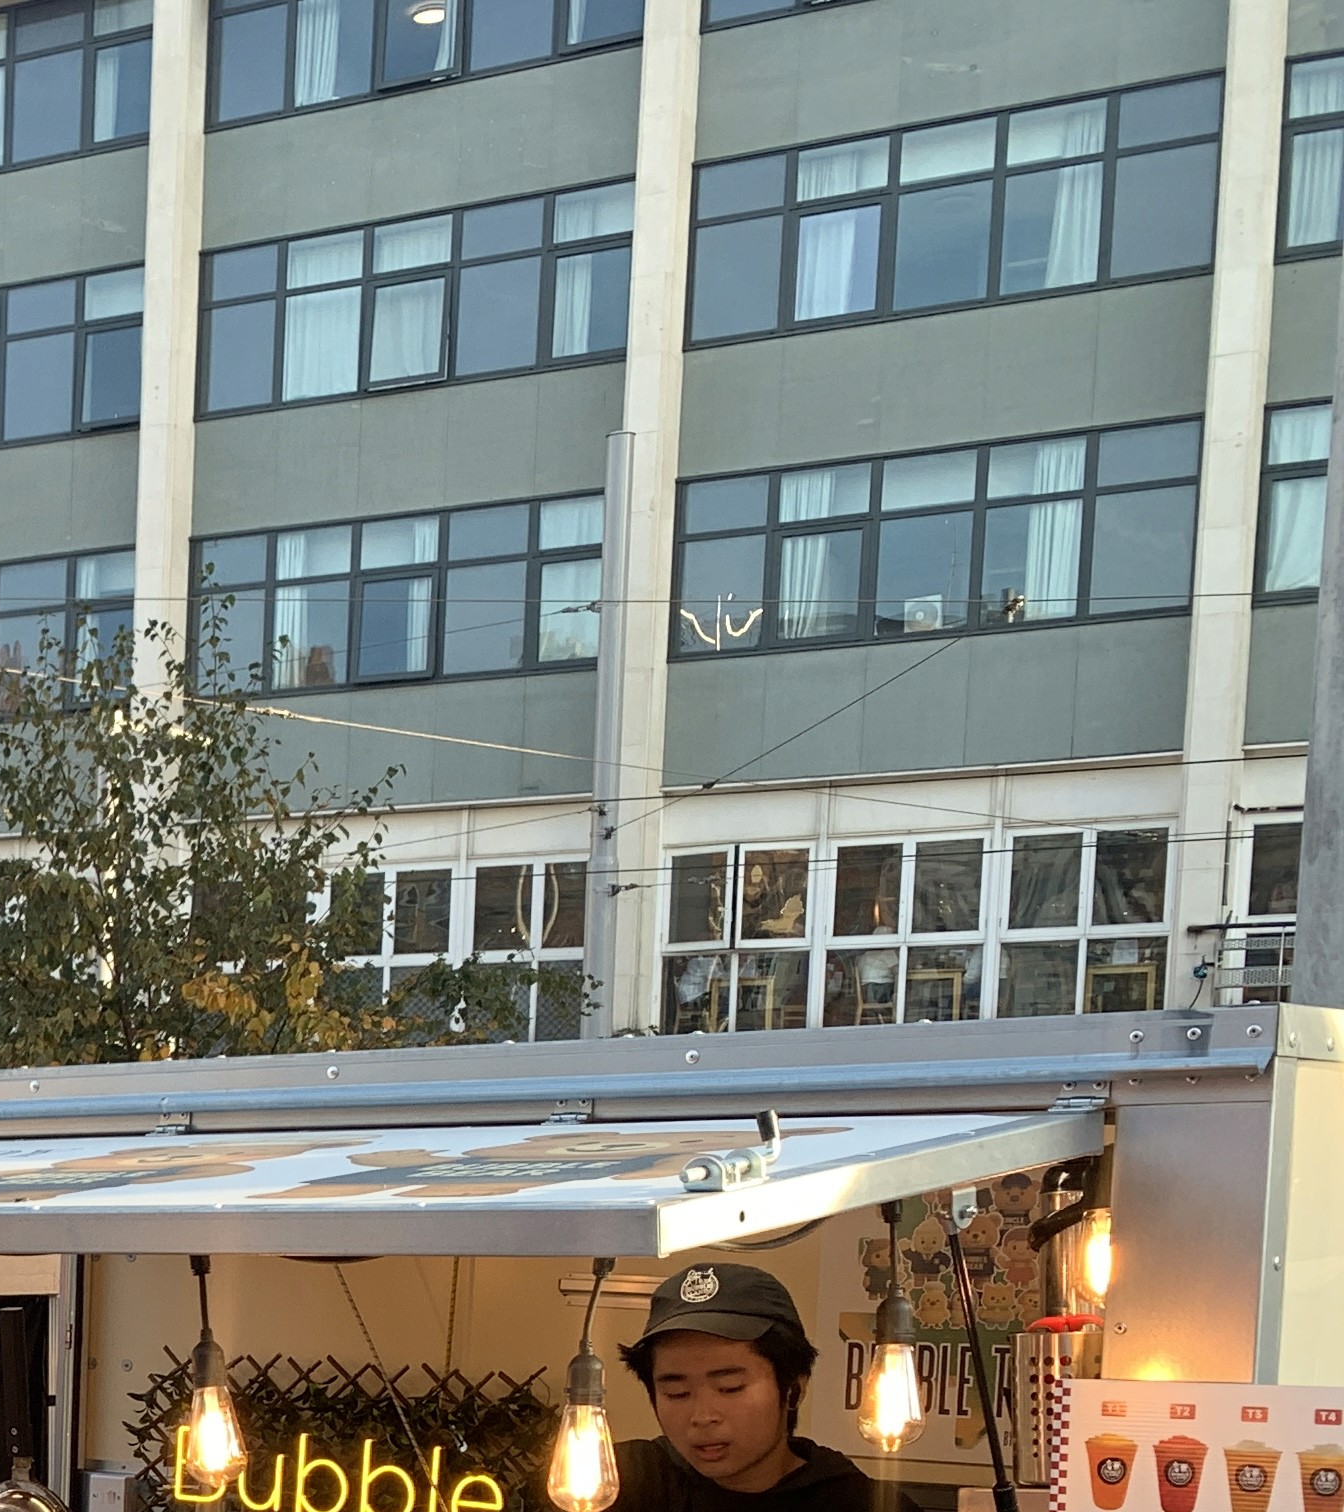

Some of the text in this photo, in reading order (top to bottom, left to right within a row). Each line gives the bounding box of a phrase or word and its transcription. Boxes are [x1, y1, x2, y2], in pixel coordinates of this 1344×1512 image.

[845, 1342, 971, 1416] BBLE
[1175, 1406, 1191, 1417] T2
[1246, 1408, 1263, 1420] T3
[1320, 1411, 1337, 1422] T4
